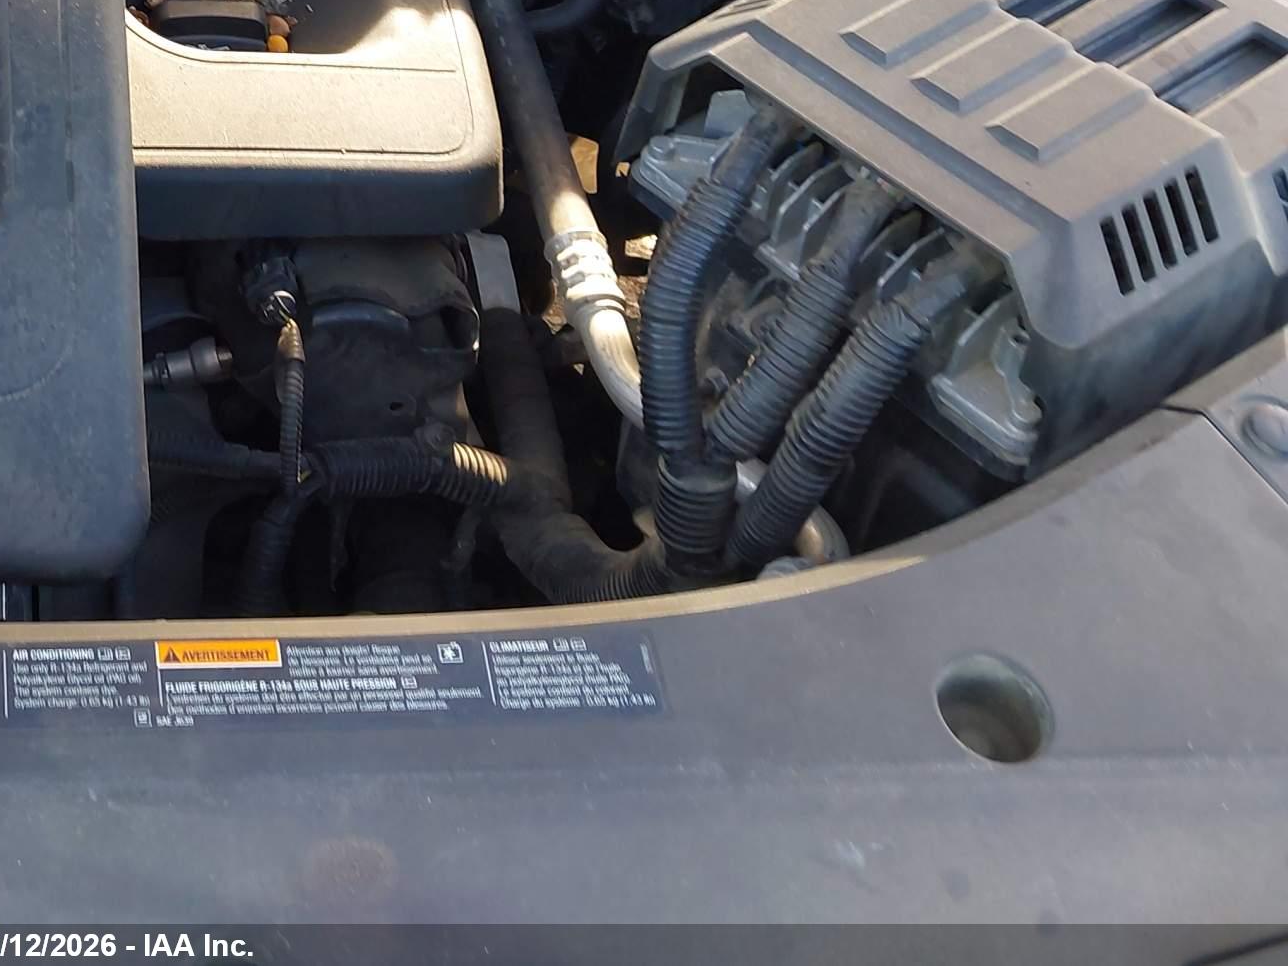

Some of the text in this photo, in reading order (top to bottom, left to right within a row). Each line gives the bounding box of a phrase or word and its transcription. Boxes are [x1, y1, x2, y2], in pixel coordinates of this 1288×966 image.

[489, 640, 549, 652] CLIMATISEUR
[13, 648, 95, 661] AIR CONDITIONING
[182, 649, 270, 662] AVERTISSEMENT
[165, 681, 198, 693] FLUIDE
[293, 679, 319, 691] SOUS
[319, 678, 350, 690] HAUTE
[351, 677, 397, 689] PRESSION
